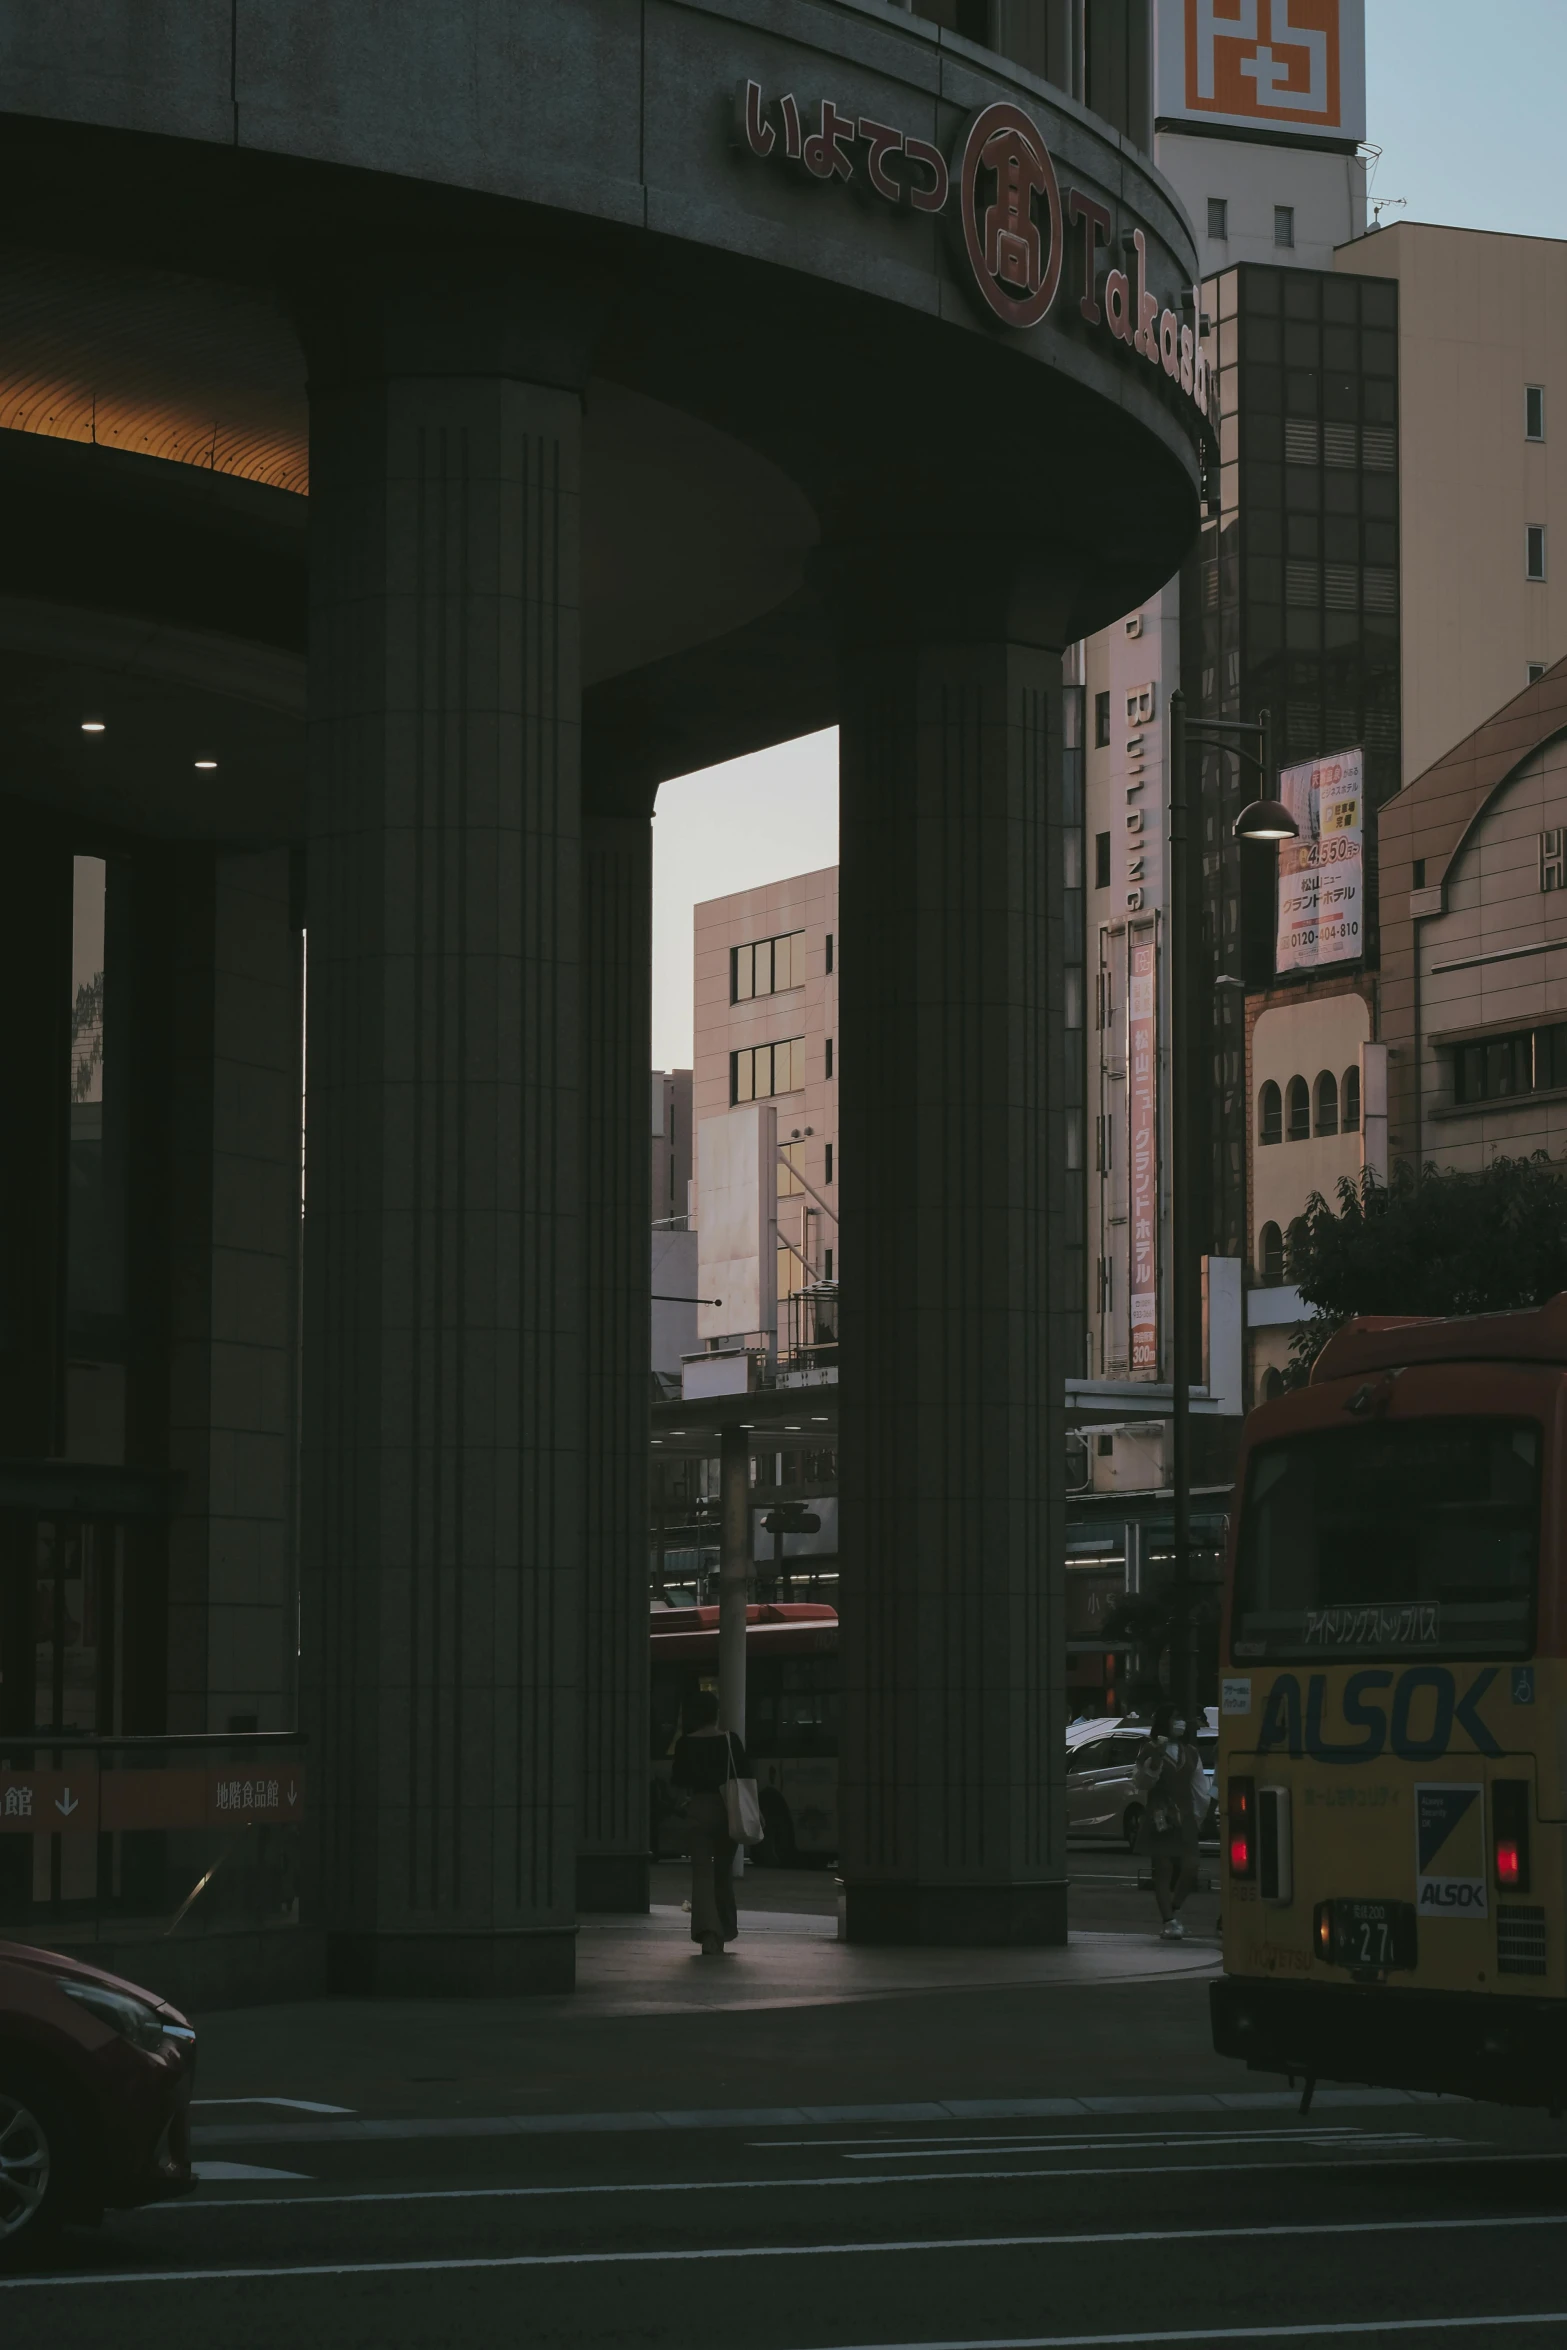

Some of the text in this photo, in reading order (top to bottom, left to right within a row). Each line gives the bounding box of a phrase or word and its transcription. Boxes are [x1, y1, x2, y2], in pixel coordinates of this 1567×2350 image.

[744, 78, 949, 213] いよてつ
[1068, 187, 1221, 430] Takash
[1301, 876, 1342, 892] 松山ニュー
[1283, 886, 1356, 914] グランドホテル
[1291, 921, 1358, 947] 0120-404-810
[1135, 1030, 1152, 1284] 松山ニューグランドホテル
[1133, 1345, 1155, 1364] 300m
[1304, 1607, 1437, 1645] アイドリングストップバス
[1256, 1667, 1507, 1765] ALSOK
[0, 1786, 33, 1817] 館
[215, 1779, 279, 1809] 地階食品館
[1420, 1883, 1485, 1907] ALSOK
